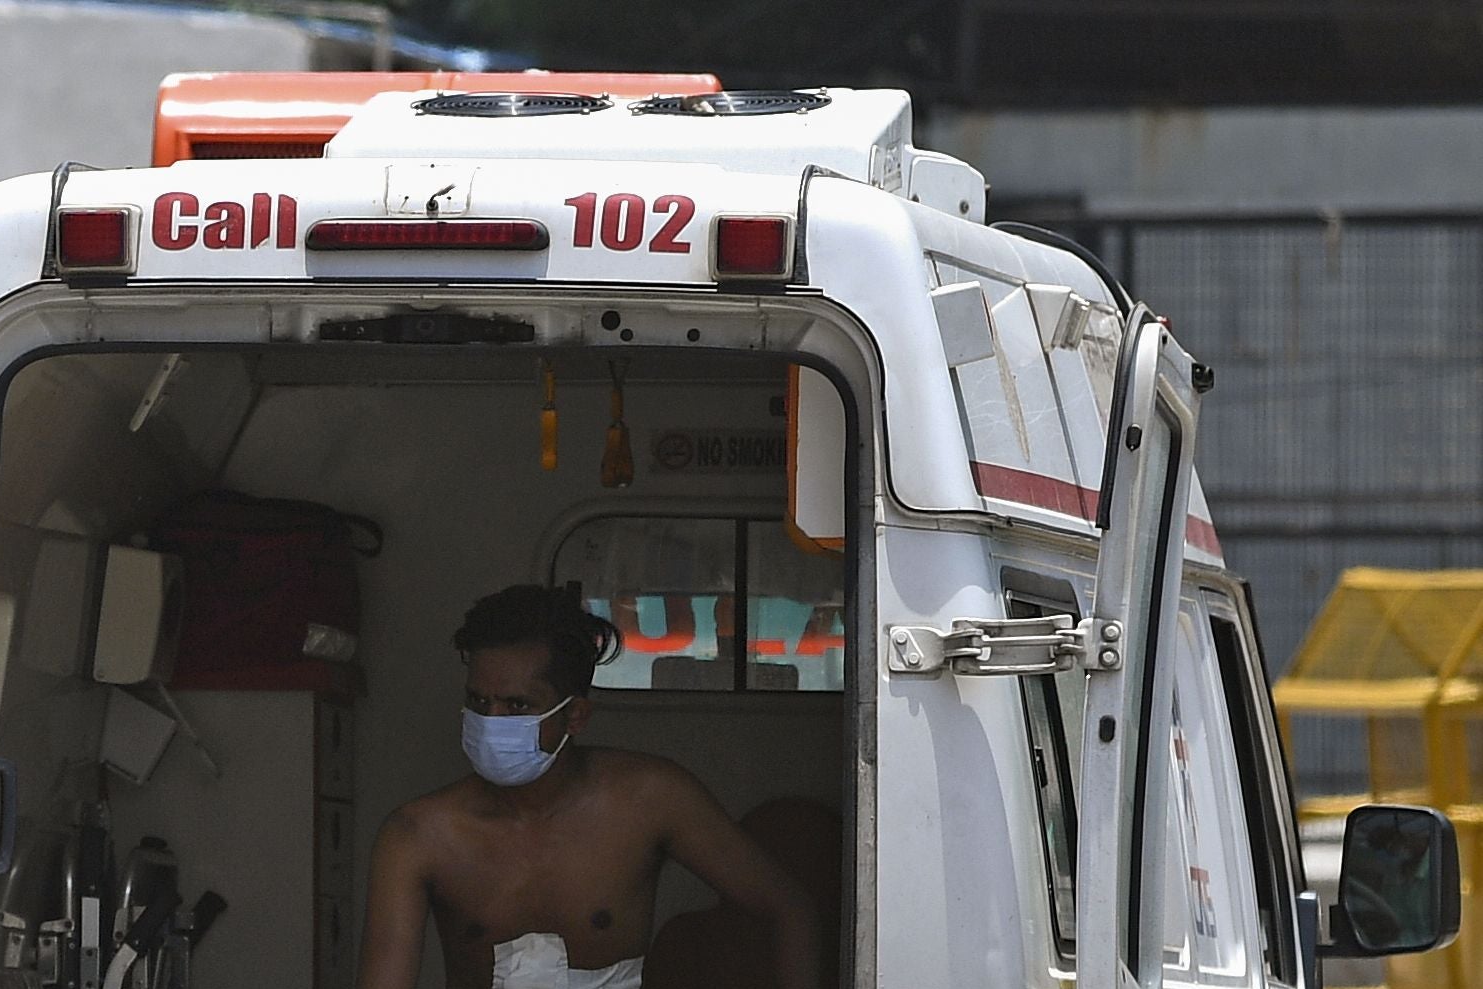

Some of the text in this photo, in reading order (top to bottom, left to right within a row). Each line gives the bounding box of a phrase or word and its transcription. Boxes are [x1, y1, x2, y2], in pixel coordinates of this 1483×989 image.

[151, 191, 693, 254] Call 102
[697, 437, 786, 466] NO SMOKI
